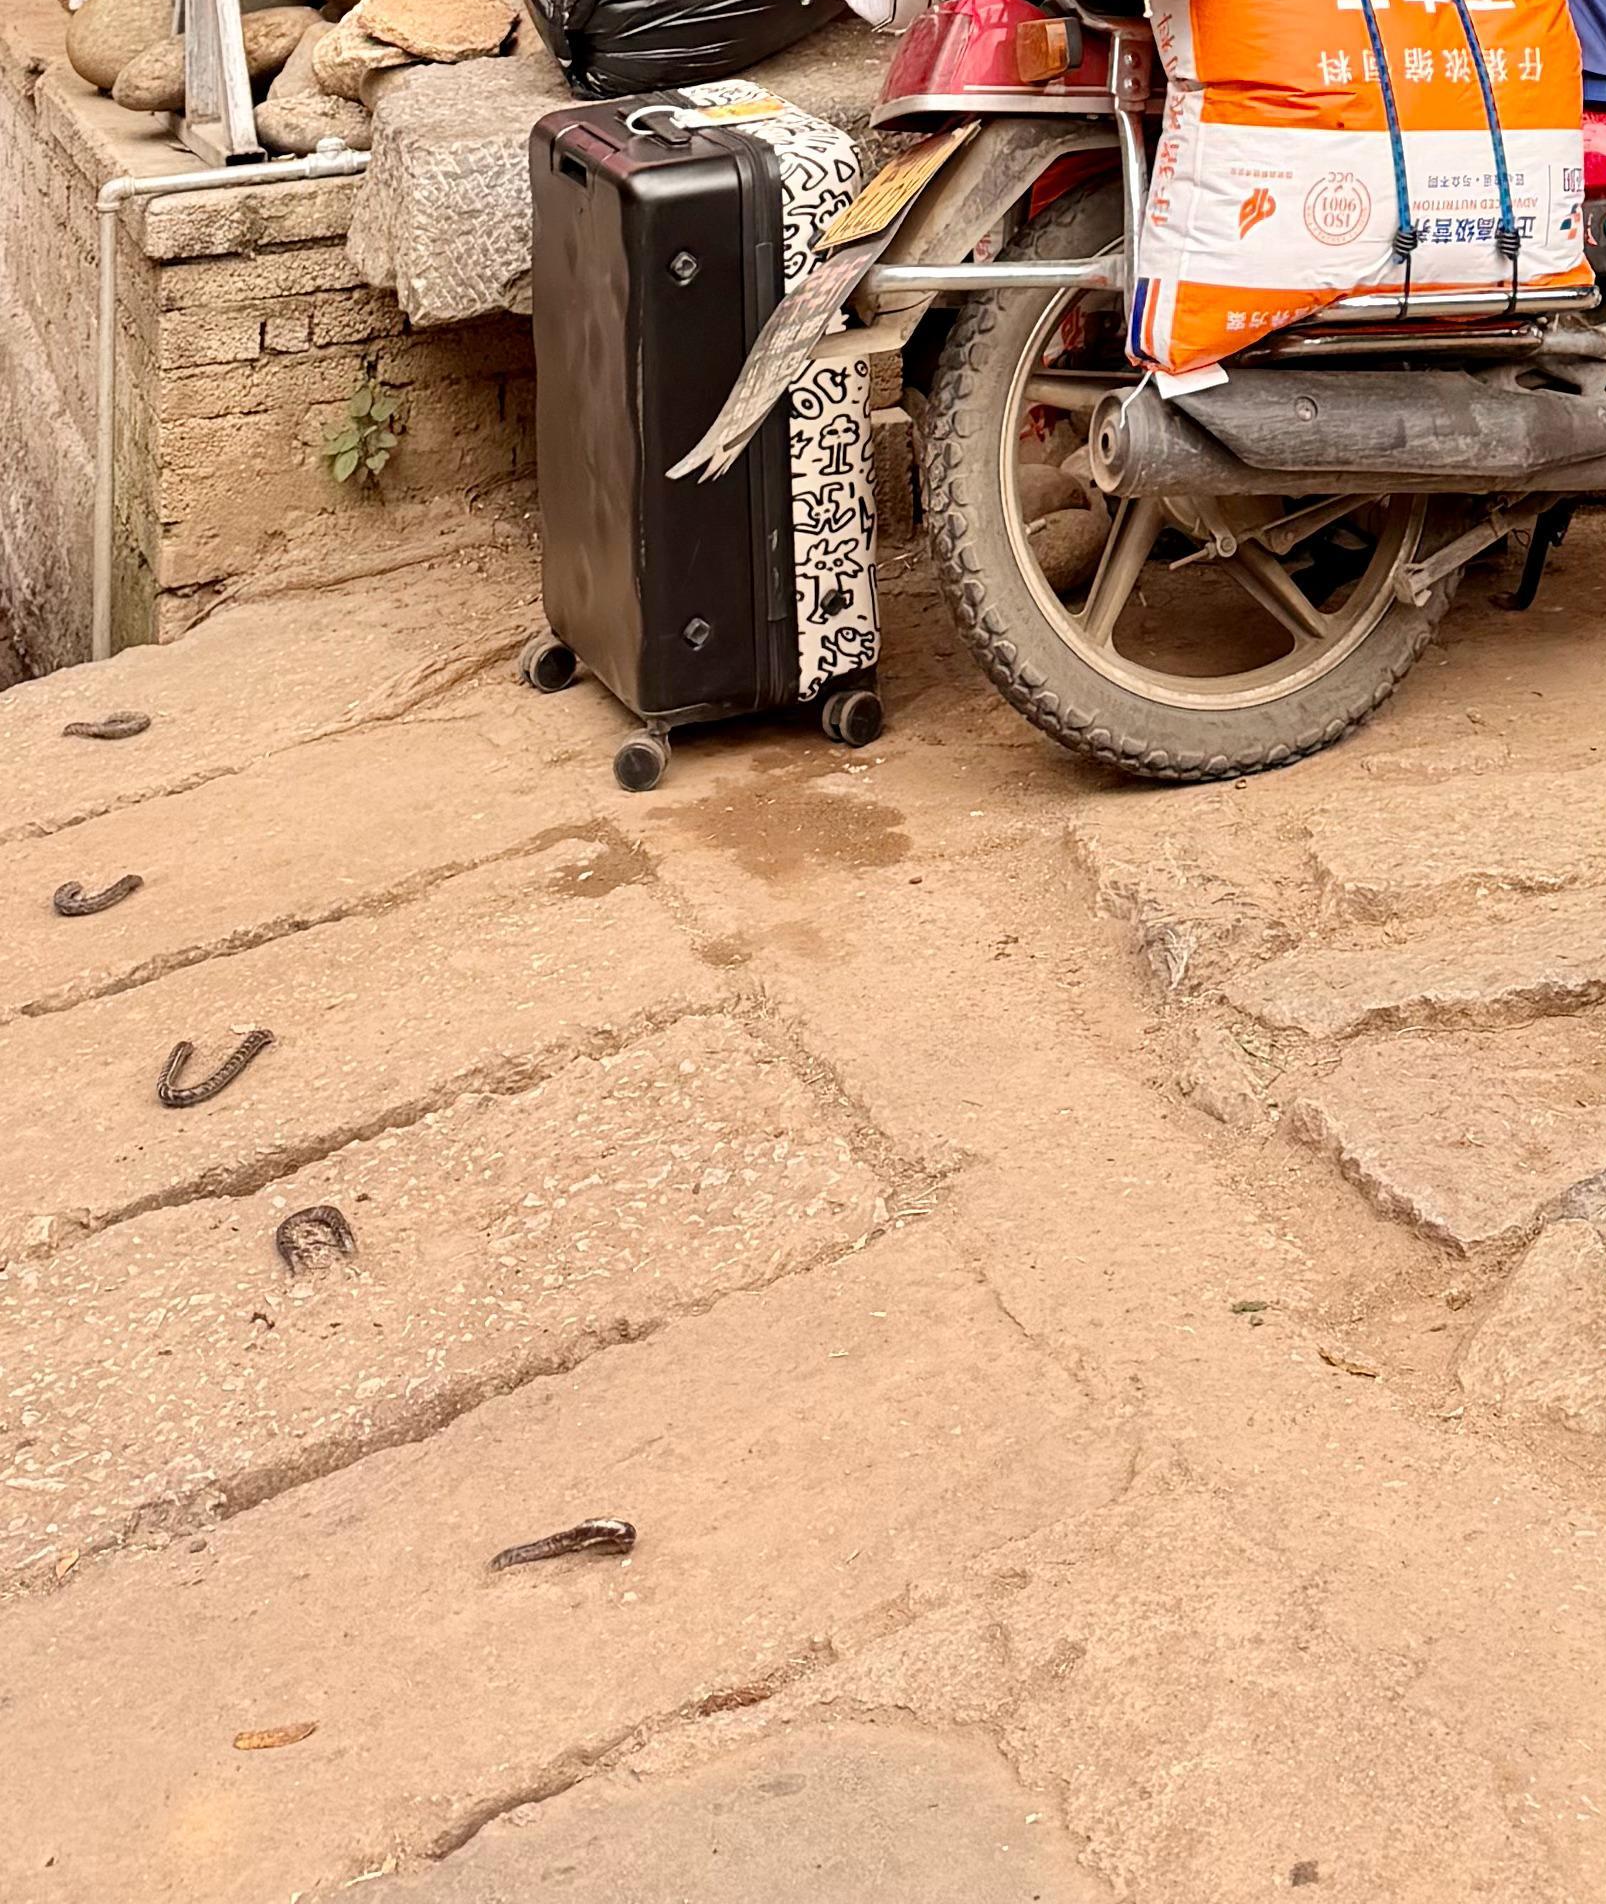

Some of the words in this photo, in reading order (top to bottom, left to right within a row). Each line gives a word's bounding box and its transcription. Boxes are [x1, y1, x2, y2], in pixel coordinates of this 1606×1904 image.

[1328, 172, 1354, 183] UCC
[1323, 197, 1357, 212] 9001
[1412, 197, 1478, 211] NUTRITION
[1324, 213, 1350, 228] ISO
